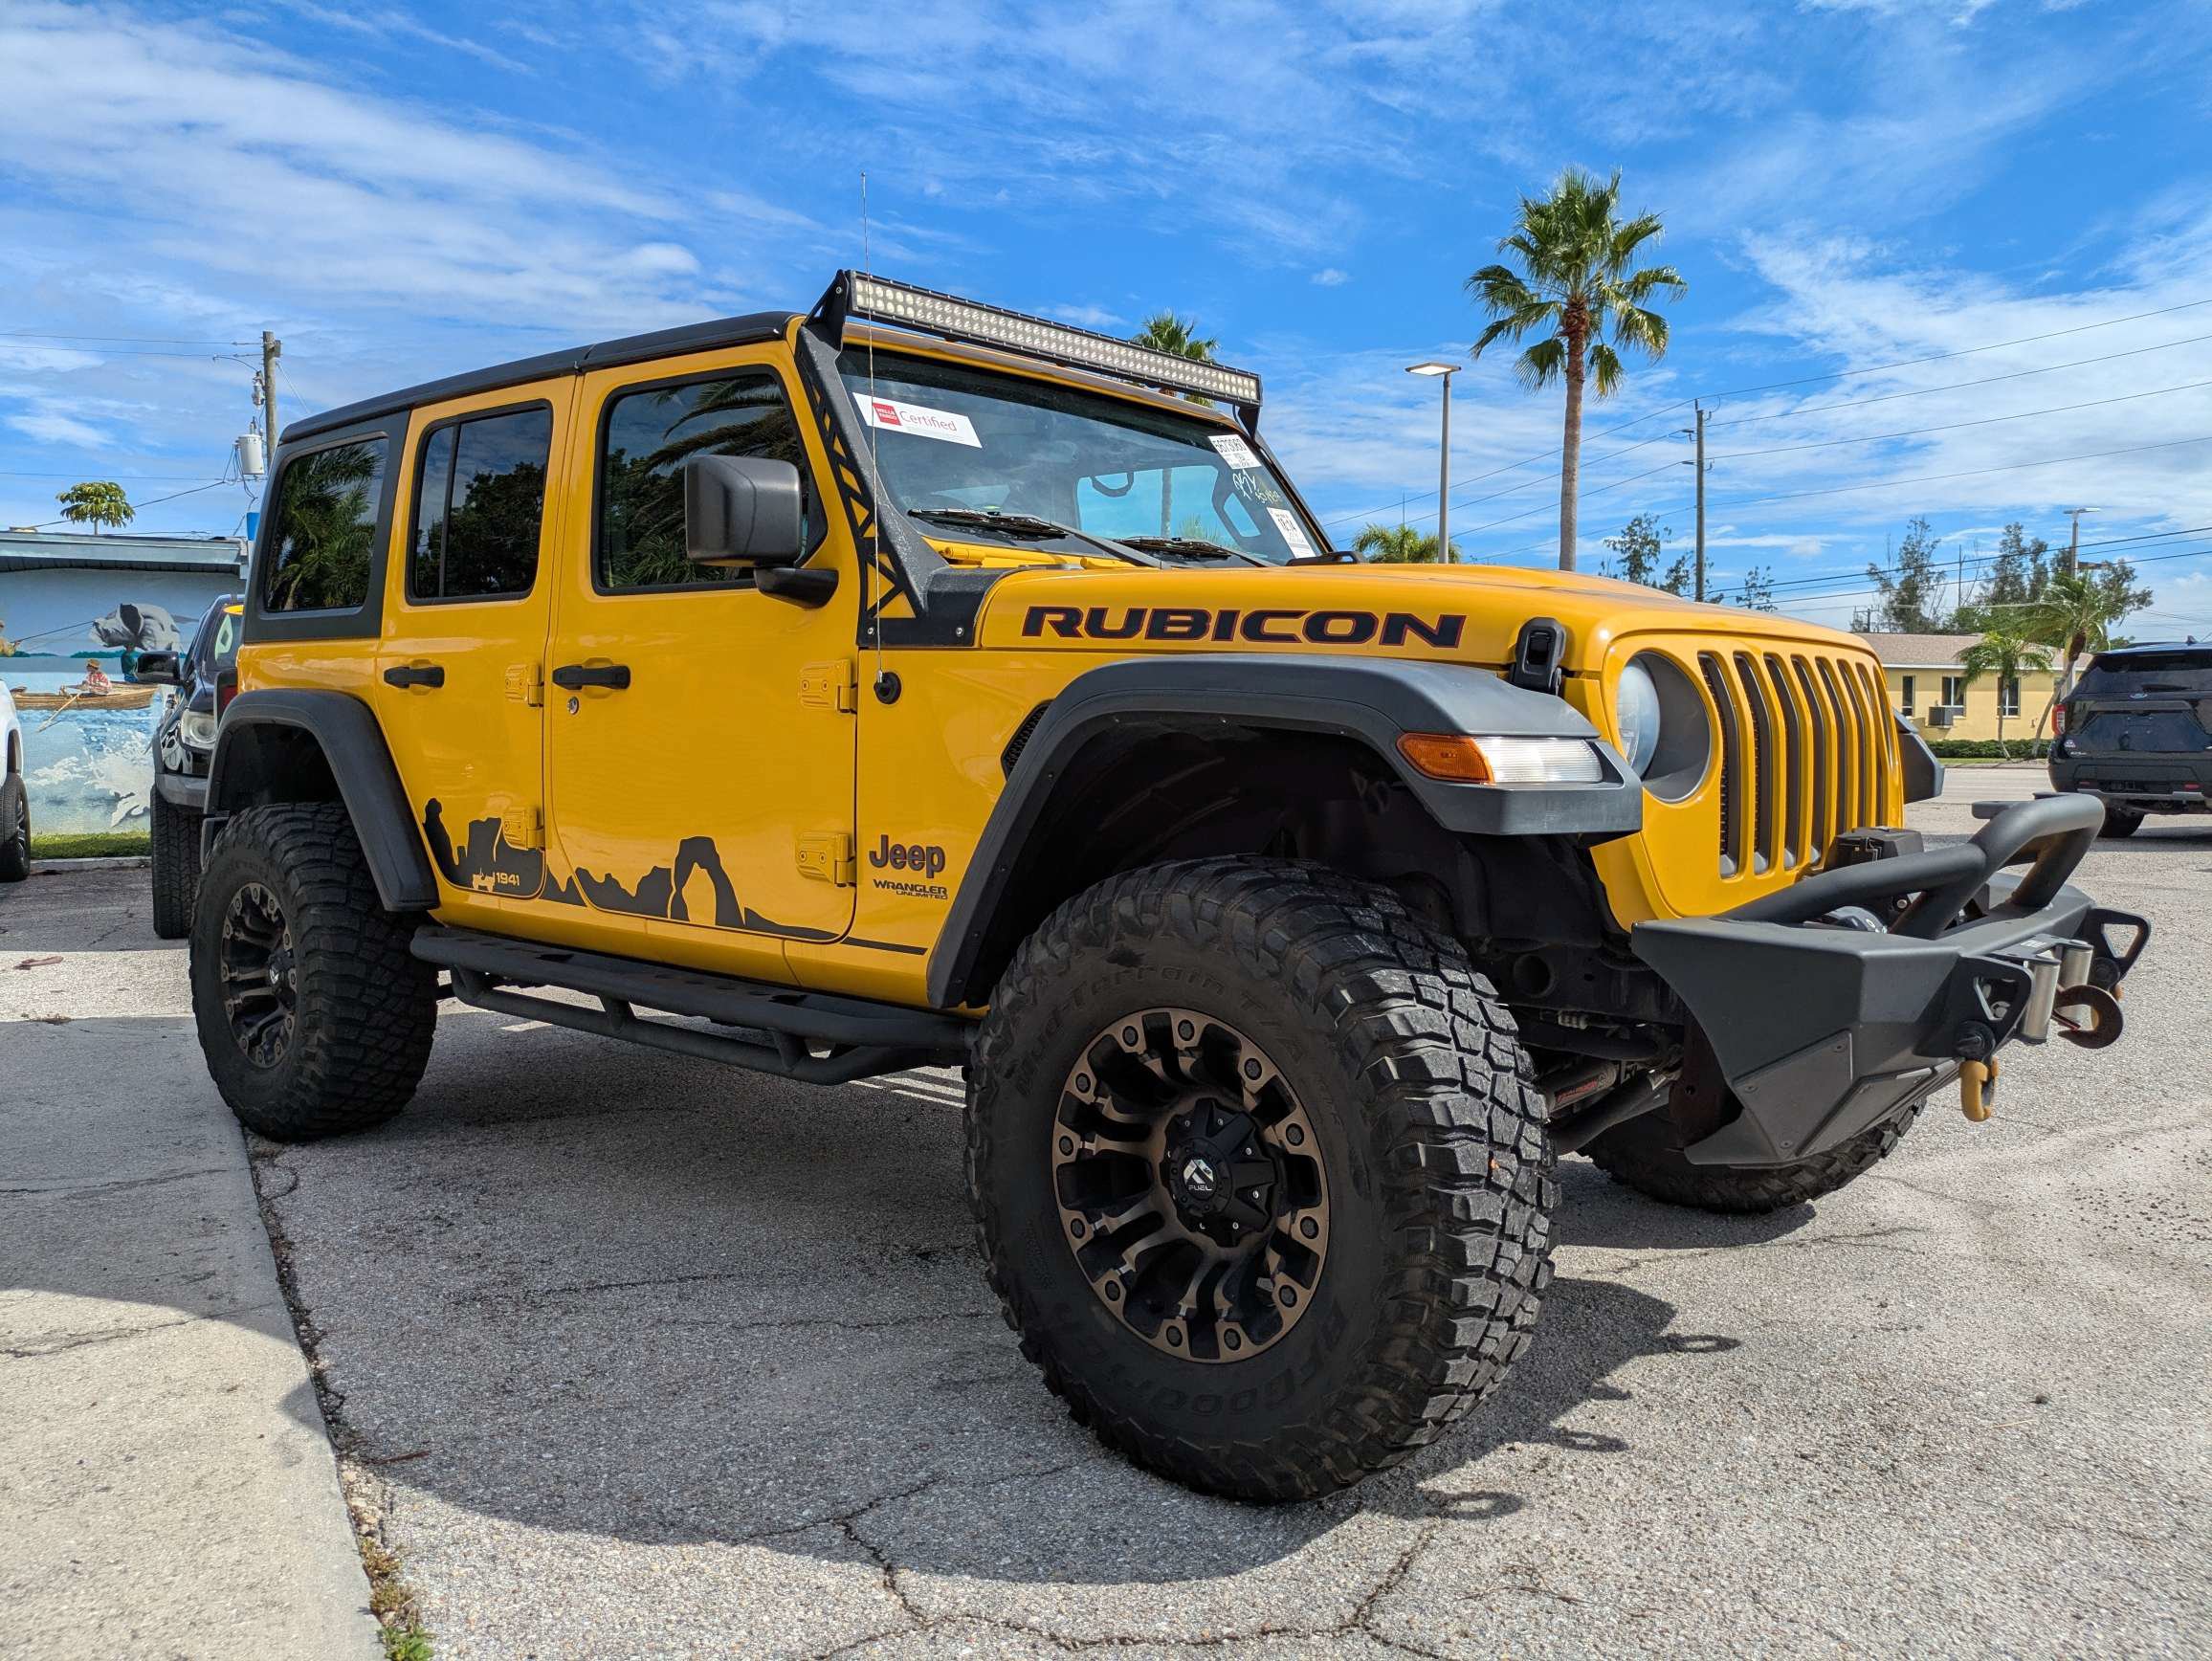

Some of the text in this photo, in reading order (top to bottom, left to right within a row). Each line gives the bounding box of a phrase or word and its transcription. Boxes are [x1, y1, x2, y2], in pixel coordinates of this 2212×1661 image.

[900, 410, 957, 432] Certified
[1021, 606, 1467, 648] RUBICON
[869, 834, 946, 879] Jeep
[496, 872, 520, 886] 1941
[874, 878, 947, 896] WRANGLER
[896, 890, 948, 900] UNLIMITED
